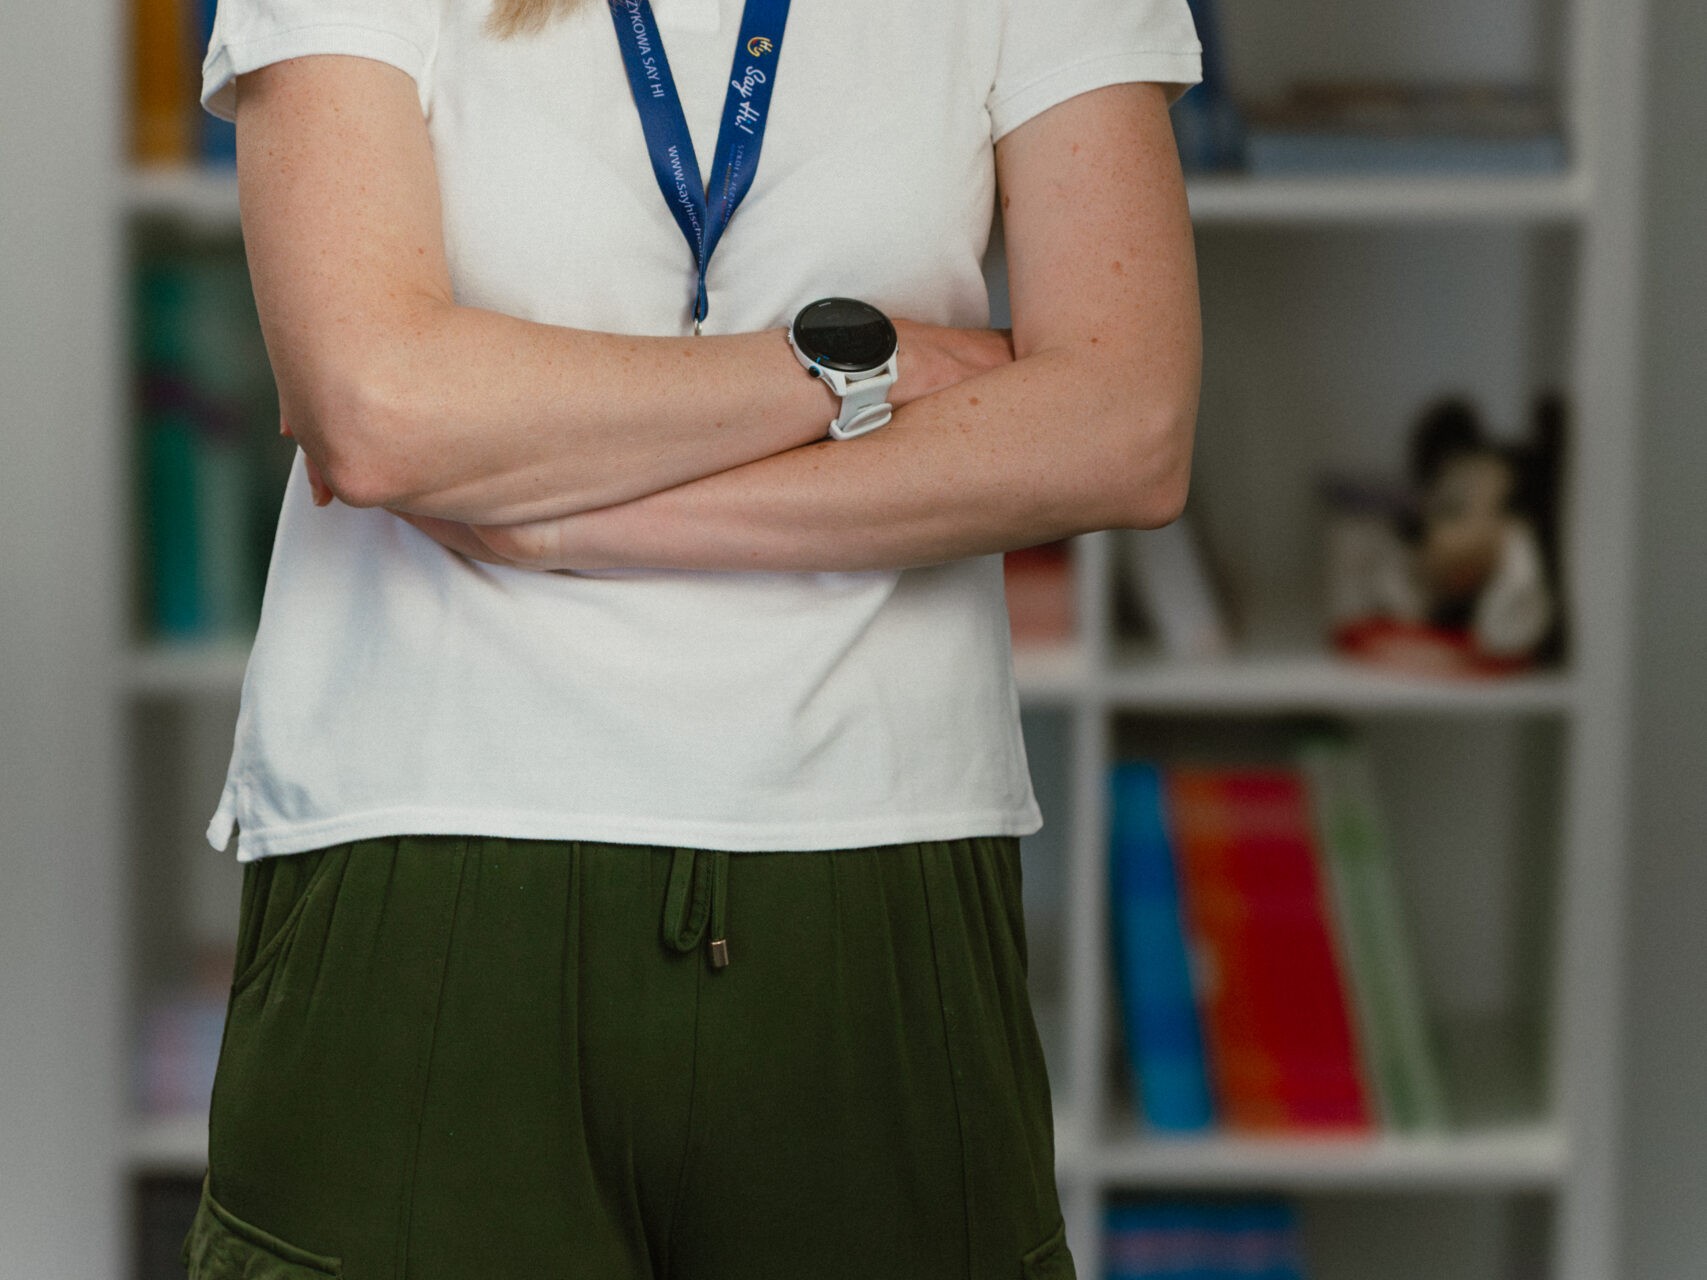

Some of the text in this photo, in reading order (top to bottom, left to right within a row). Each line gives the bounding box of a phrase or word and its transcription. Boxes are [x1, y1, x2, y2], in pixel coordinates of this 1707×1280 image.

[642, 55, 661, 81] SAY
[650, 82, 665, 98] HI
[731, 65, 767, 135] Say Hi!
